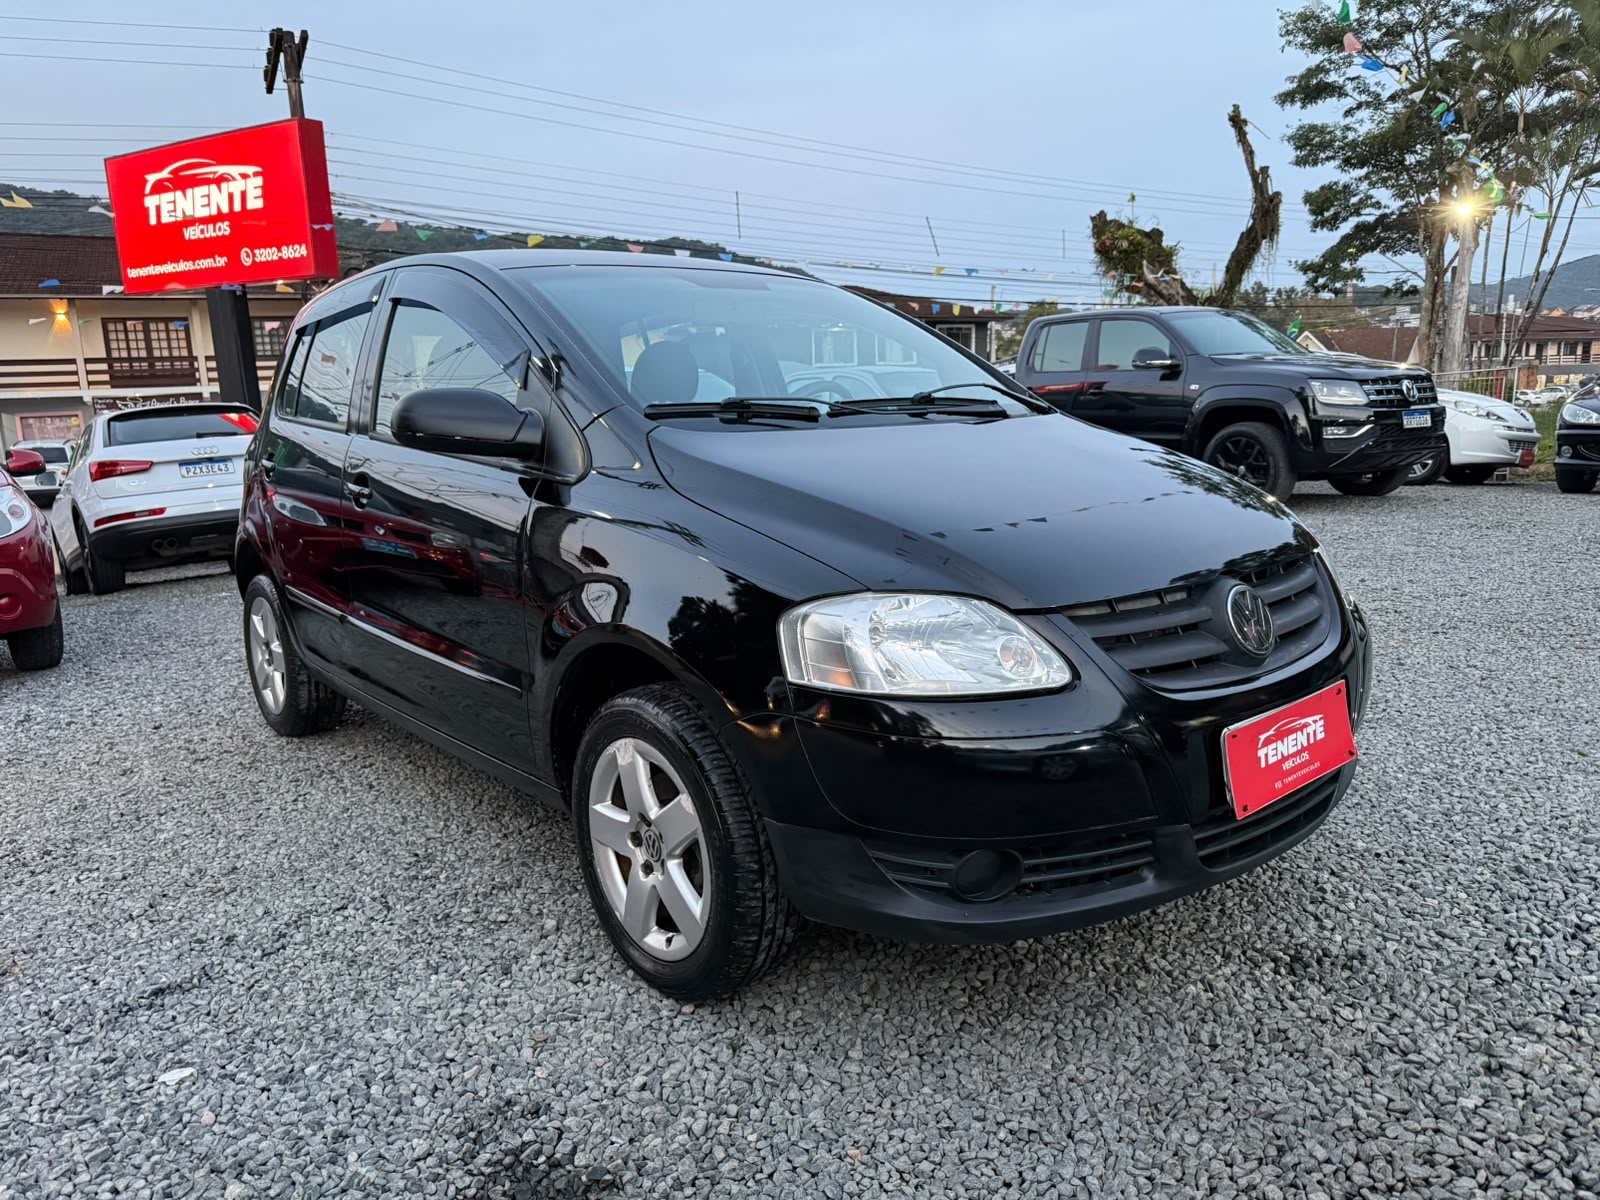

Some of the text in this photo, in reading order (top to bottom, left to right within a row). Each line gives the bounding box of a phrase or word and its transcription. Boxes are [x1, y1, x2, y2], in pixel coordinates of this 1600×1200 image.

[144, 175, 264, 226] TENENTE
[183, 221, 230, 241] VEÍCULOS
[254, 244, 307, 262] 3202-8624
[127, 255, 228, 279] tenenteveiculos.com.br
[185, 463, 229, 475] PZX3E43
[1257, 719, 1325, 768] TENENTE
